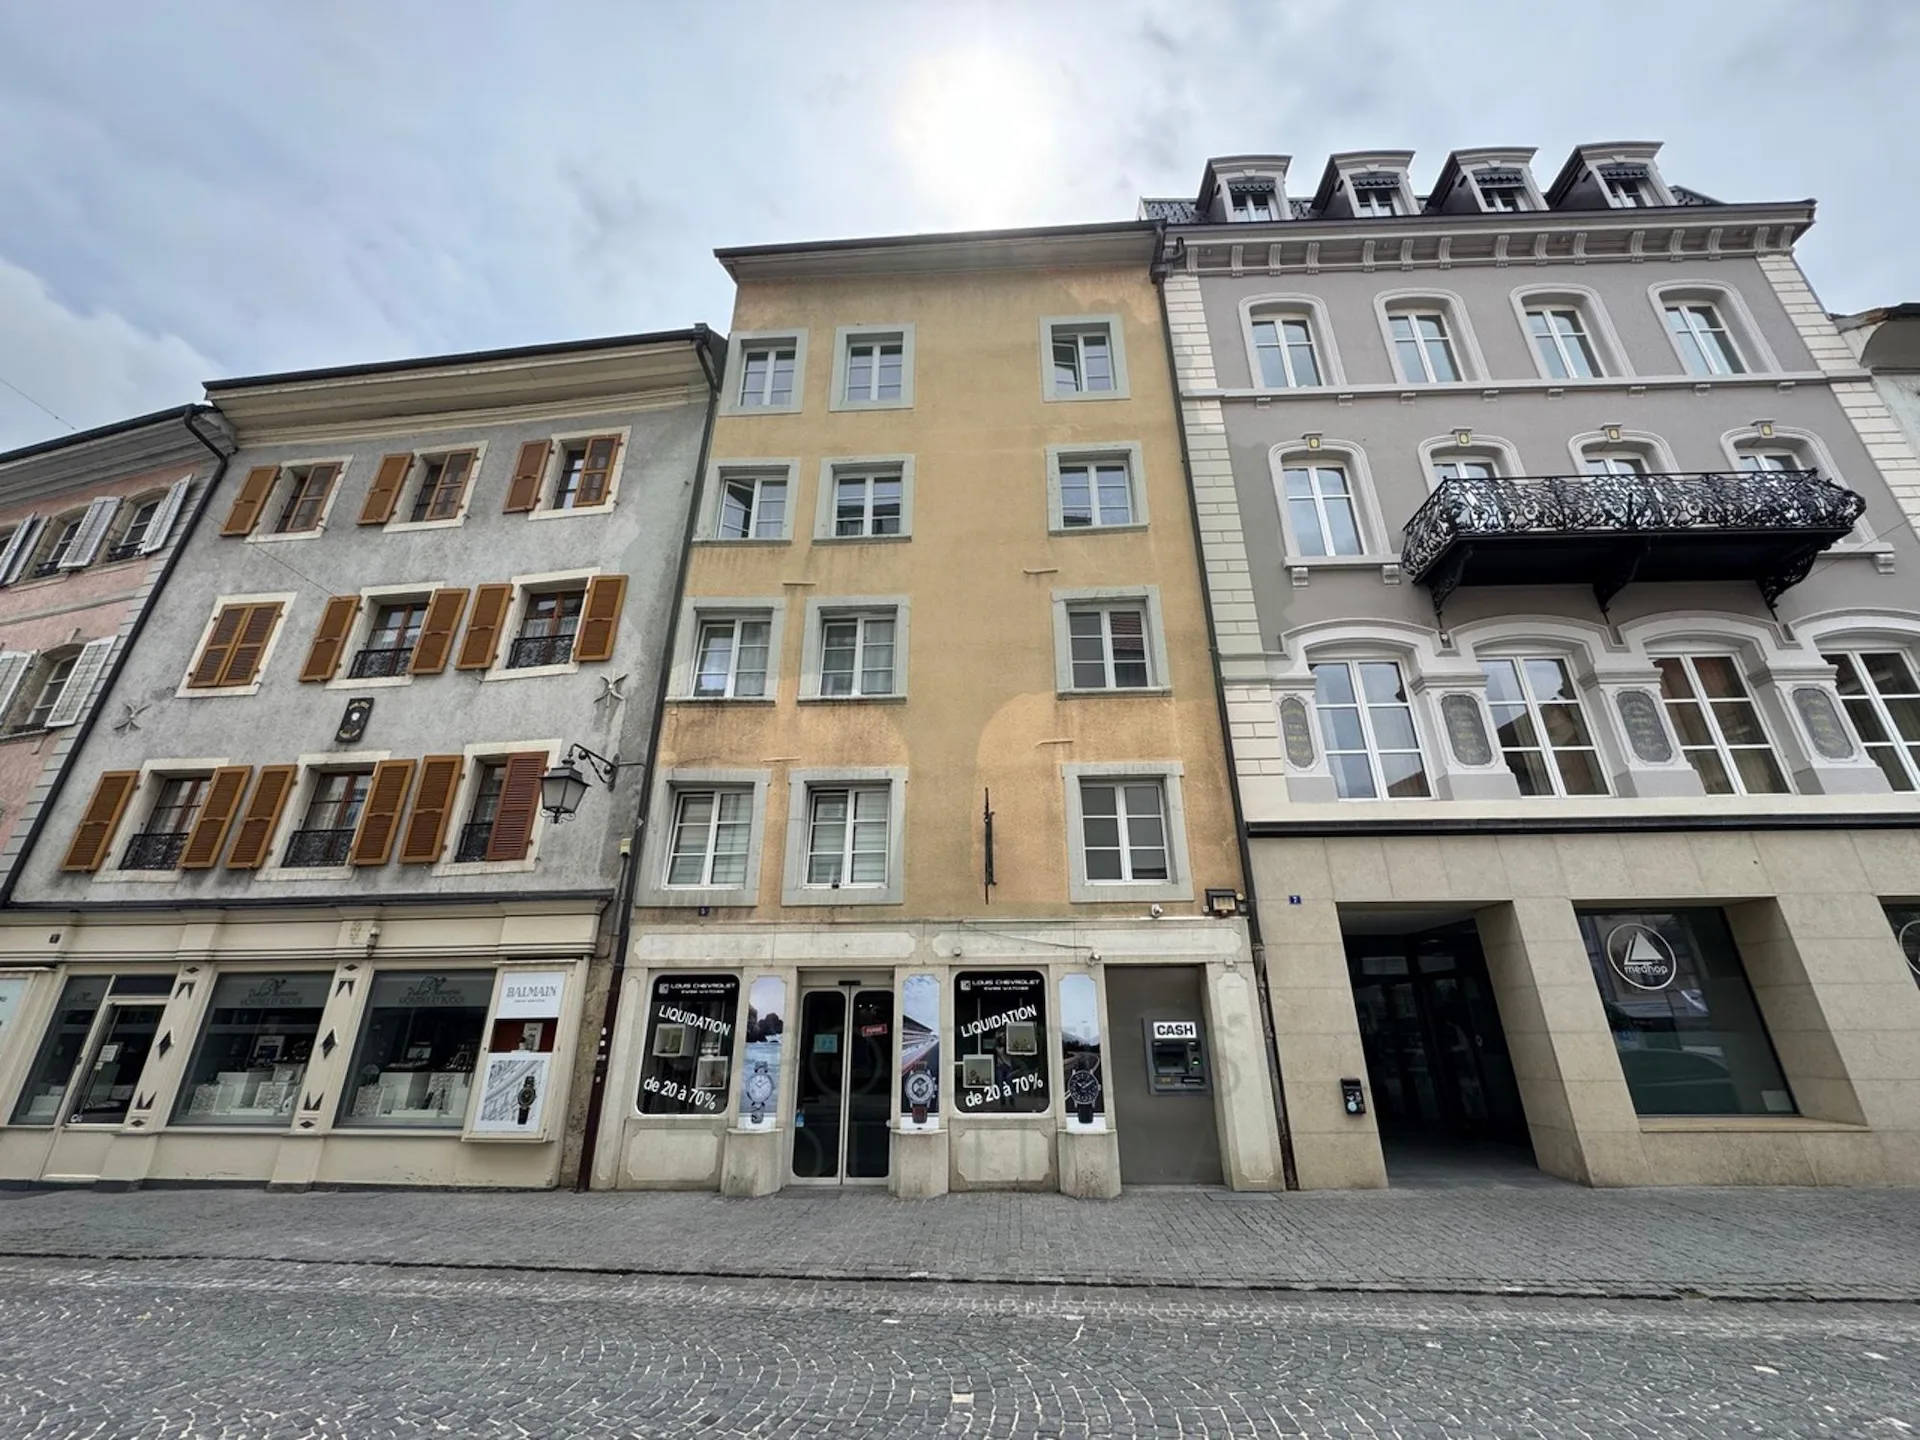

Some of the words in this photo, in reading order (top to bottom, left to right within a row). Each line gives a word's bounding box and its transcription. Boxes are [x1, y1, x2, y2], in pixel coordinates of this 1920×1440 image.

[505, 985, 558, 998] BALMAIN
[658, 1004, 732, 1036] LIQUIDATION
[960, 1004, 1037, 1038] LIQUIDATION
[1156, 1024, 1194, 1036] CASH
[643, 1076, 660, 1093] de
[660, 1080, 678, 1098] 20
[677, 1085, 688, 1102] à
[688, 1088, 717, 1110] 70%
[965, 1090, 983, 1107] de
[983, 1084, 1001, 1102] 20
[1002, 1081, 1012, 1097] à
[1012, 1072, 1044, 1094] 70%
